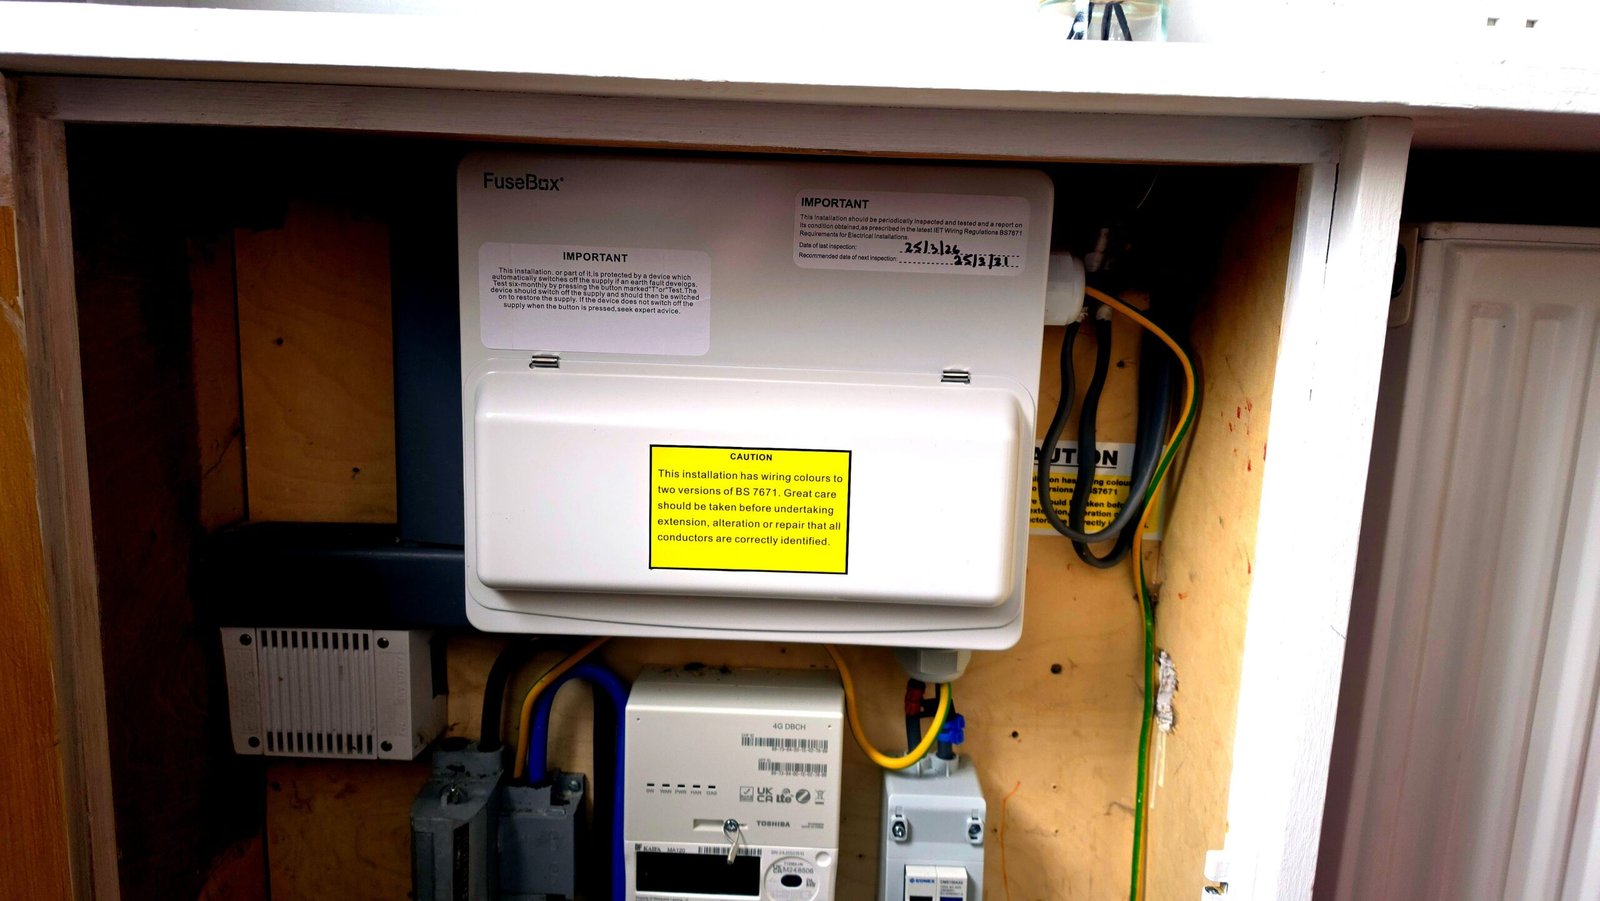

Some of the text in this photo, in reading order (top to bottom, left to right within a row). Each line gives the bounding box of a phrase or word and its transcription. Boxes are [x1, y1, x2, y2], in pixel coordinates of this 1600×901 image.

[483, 172, 560, 191] FuseBox
[801, 197, 870, 209] IMPORTANT
[563, 251, 628, 263] IMPORTANT
[491, 273, 537, 283] automatically
[592, 278, 613, 286] supply
[600, 271, 632, 279] protected
[634, 272, 641, 280] by
[509, 280, 548, 290] six-monthly
[549, 282, 557, 290] by
[558, 283, 587, 291] pressing
[583, 290, 605, 299] supply
[503, 302, 525, 310] supply
[730, 452, 773, 461] CAUTION
[658, 469, 843, 484] This installation has wiring colours to
[658, 485, 676, 494] two
[678, 486, 720, 495] versions
[723, 486, 734, 495] of
[736, 487, 750, 496] BS
[753, 487, 781, 496] 7671.
[784, 488, 812, 497] Great
[658, 501, 834, 517] should be taken before undertaking
[658, 517, 710, 528] extension,
[712, 518, 760, 528] alteration
[775, 520, 805, 531] repair
[808, 520, 826, 530] that
[829, 521, 841, 530] all
[657, 532, 714, 542] conductors
[735, 535, 778, 546] correctly
[781, 535, 830, 545] identified.
[772, 722, 806, 731] 4G DBCH
[757, 787, 773, 795] UK
[757, 795, 773, 803] CA
[757, 820, 790, 828] TOSHIBA
